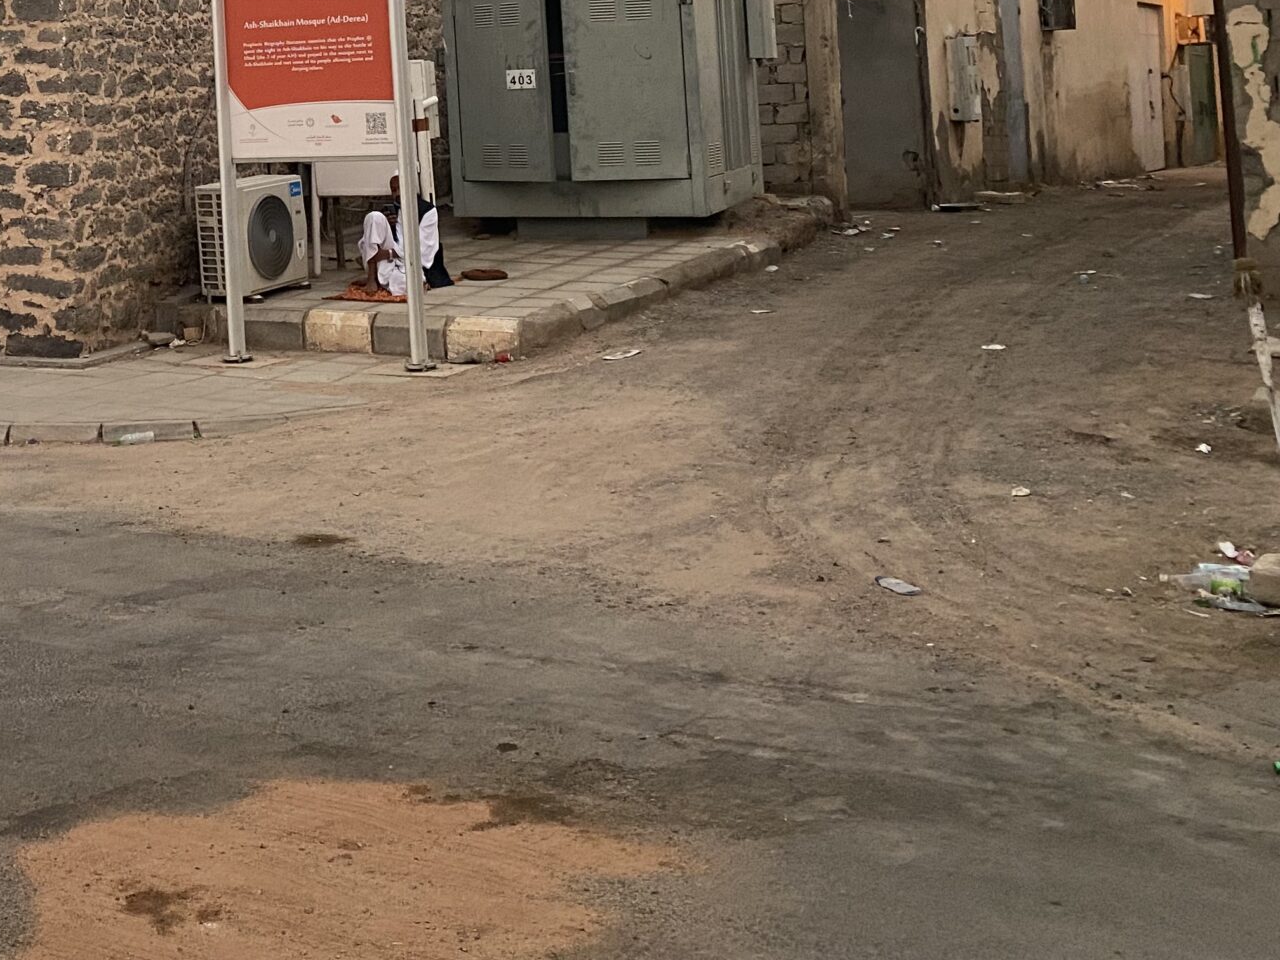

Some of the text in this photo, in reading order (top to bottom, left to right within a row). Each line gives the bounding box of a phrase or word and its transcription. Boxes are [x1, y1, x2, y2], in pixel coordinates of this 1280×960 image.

[243, 13, 369, 30] Ash-Shaikhain Mosque (Ad-Derea)
[510, 75, 533, 86] 403
